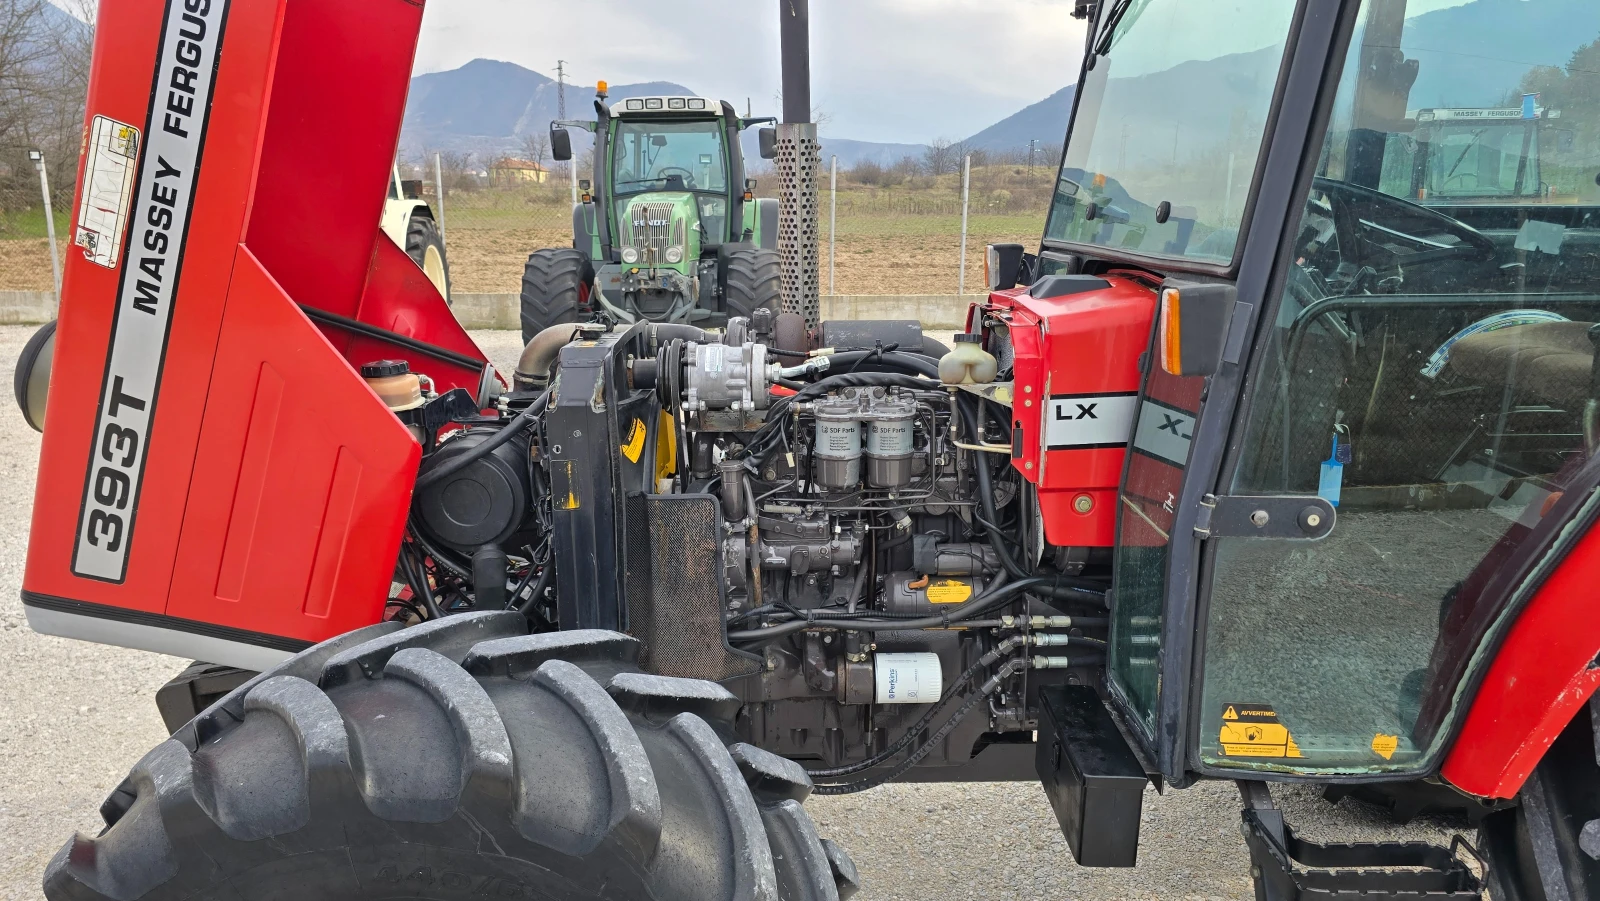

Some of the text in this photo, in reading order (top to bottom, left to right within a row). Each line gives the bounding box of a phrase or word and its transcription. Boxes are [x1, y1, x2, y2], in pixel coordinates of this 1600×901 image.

[133, 155, 182, 315] MASSEY
[87, 374, 147, 552] 393T
[1056, 402, 1098, 420] LX
